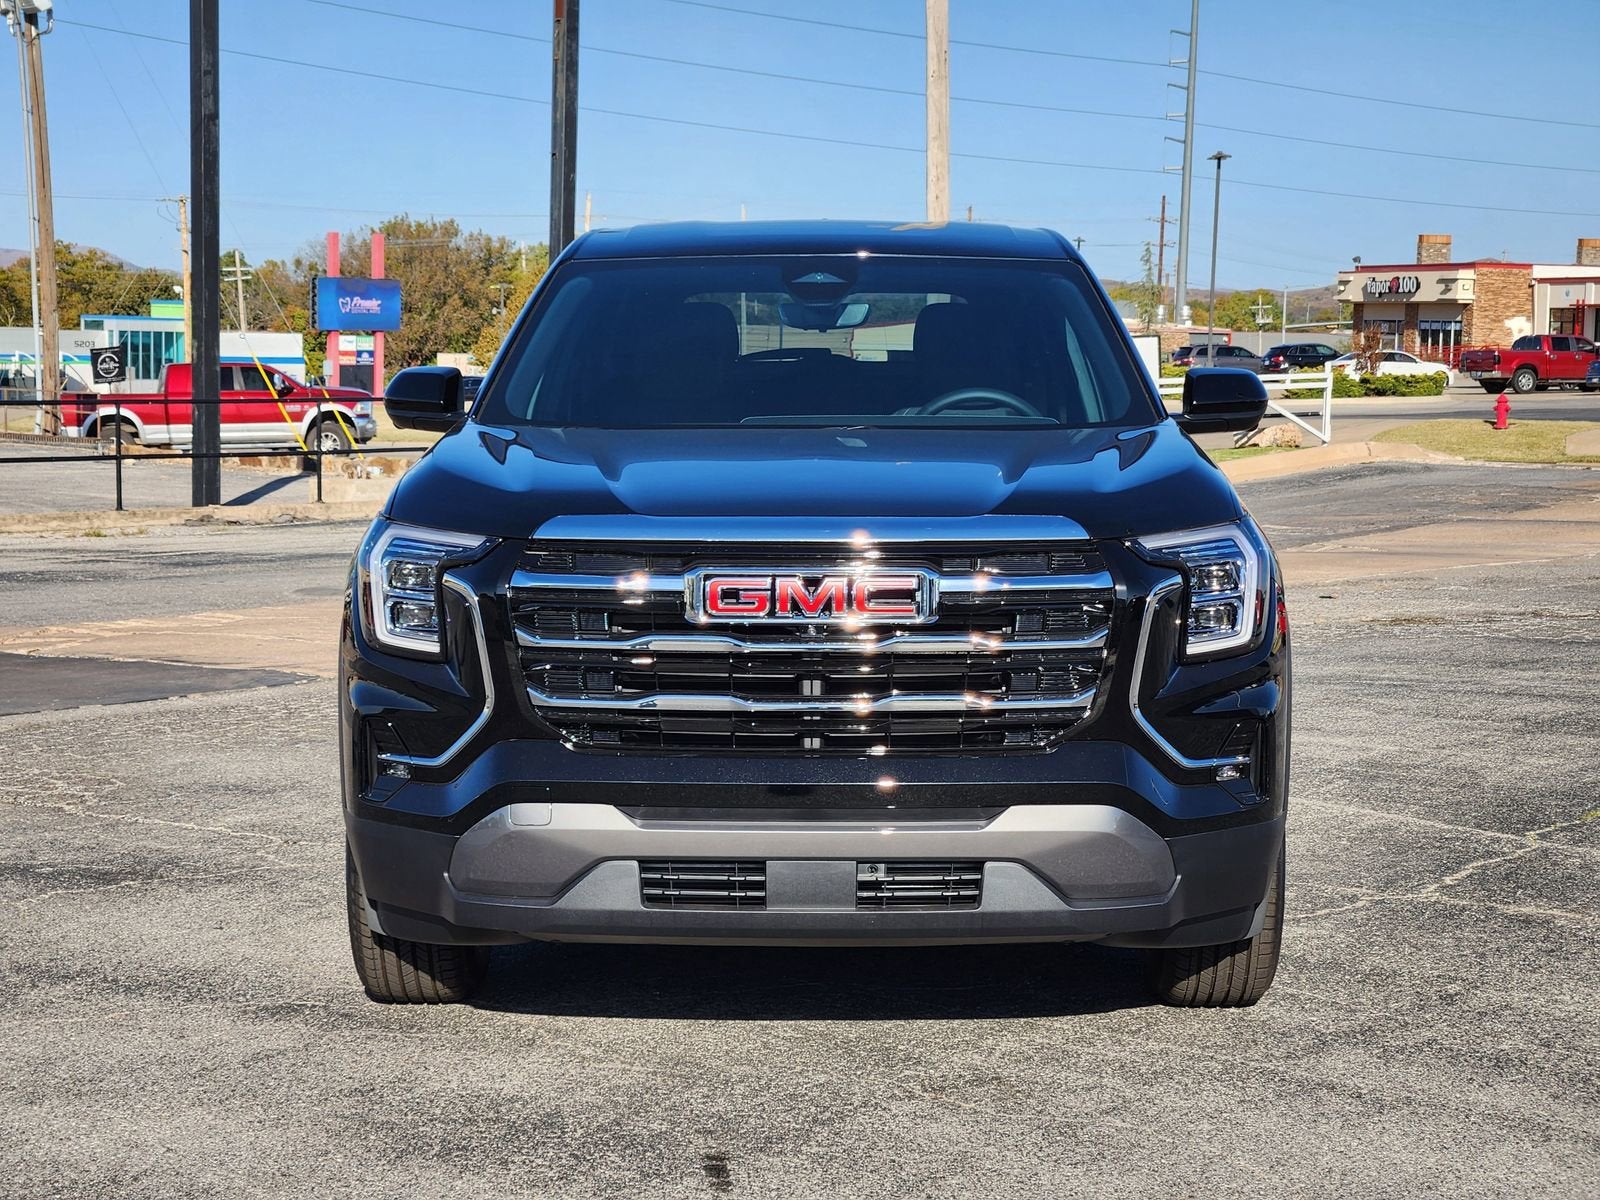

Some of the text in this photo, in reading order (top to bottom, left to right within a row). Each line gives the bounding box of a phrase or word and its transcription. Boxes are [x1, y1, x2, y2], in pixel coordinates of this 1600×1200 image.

[1367, 276, 1418, 298] Vapor 100
[74, 340, 96, 348] 5203
[706, 575, 918, 618] GMC
